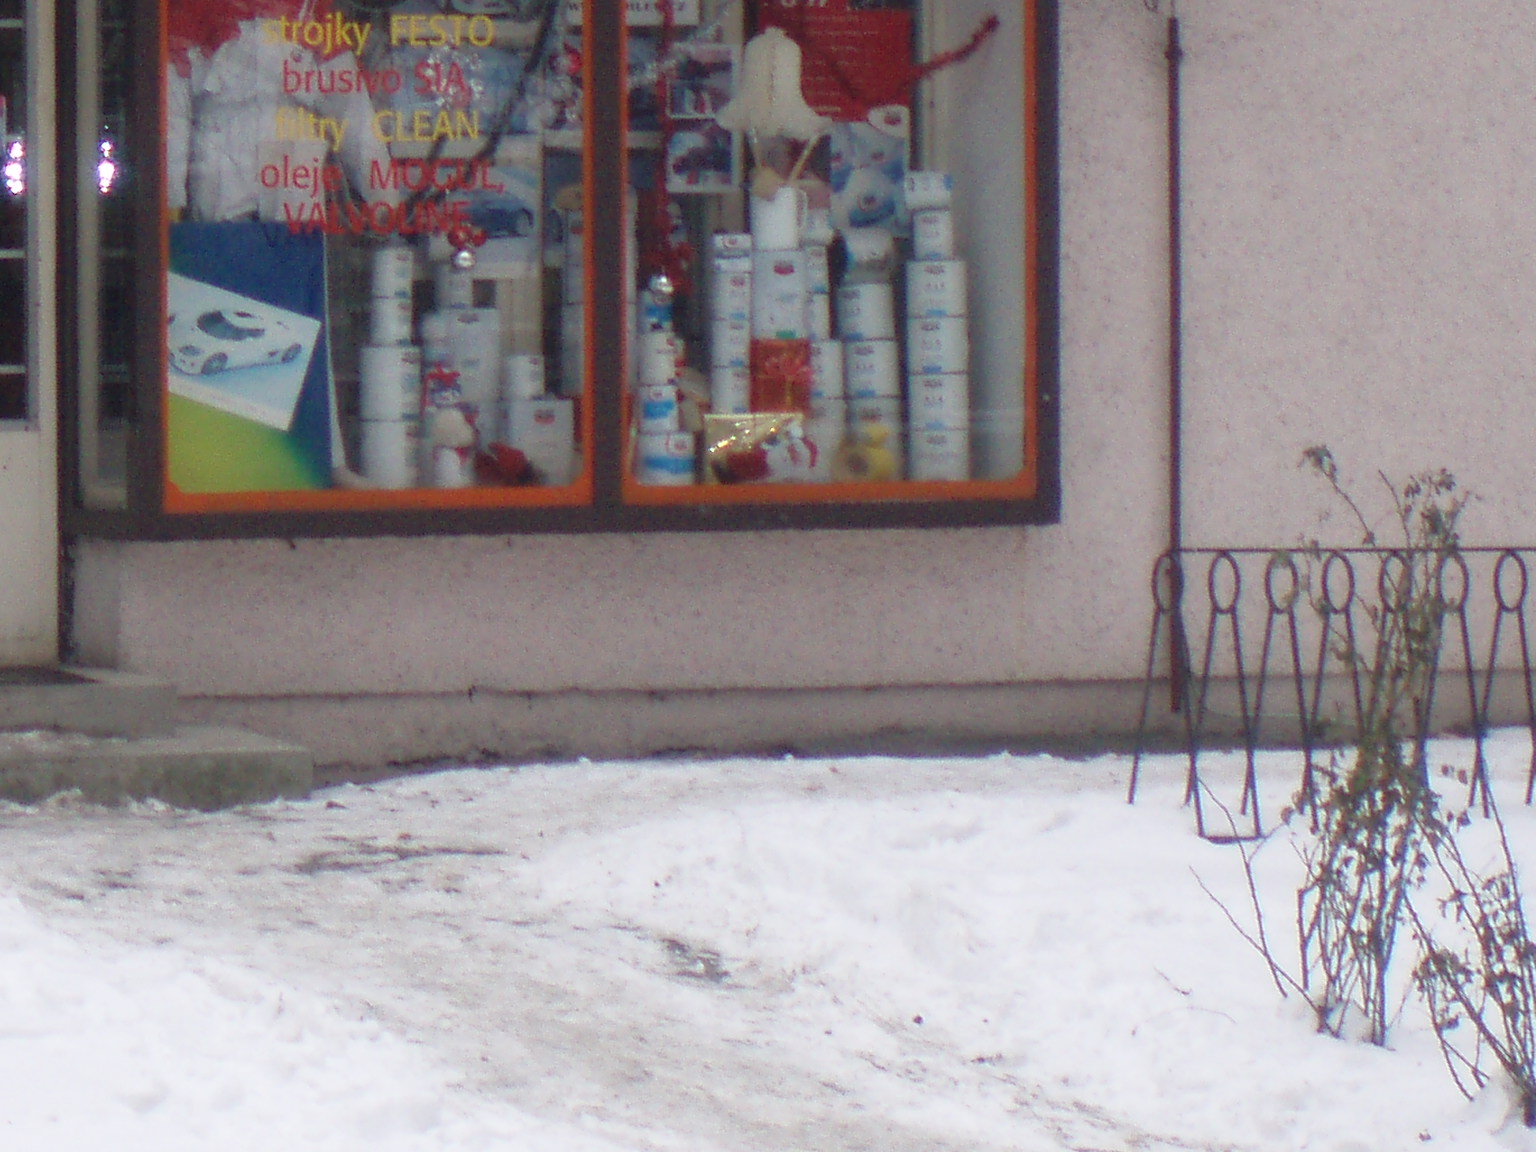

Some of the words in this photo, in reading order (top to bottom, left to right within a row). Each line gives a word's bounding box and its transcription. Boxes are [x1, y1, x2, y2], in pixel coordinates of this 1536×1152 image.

[261, 11, 372, 55] strojky
[390, 14, 495, 47] FESTO
[282, 59, 403, 95] brusivo
[275, 106, 348, 152] filtry
[371, 110, 479, 142] CLEAN
[261, 155, 342, 198] oleje
[370, 157, 506, 194] MOGUL,
